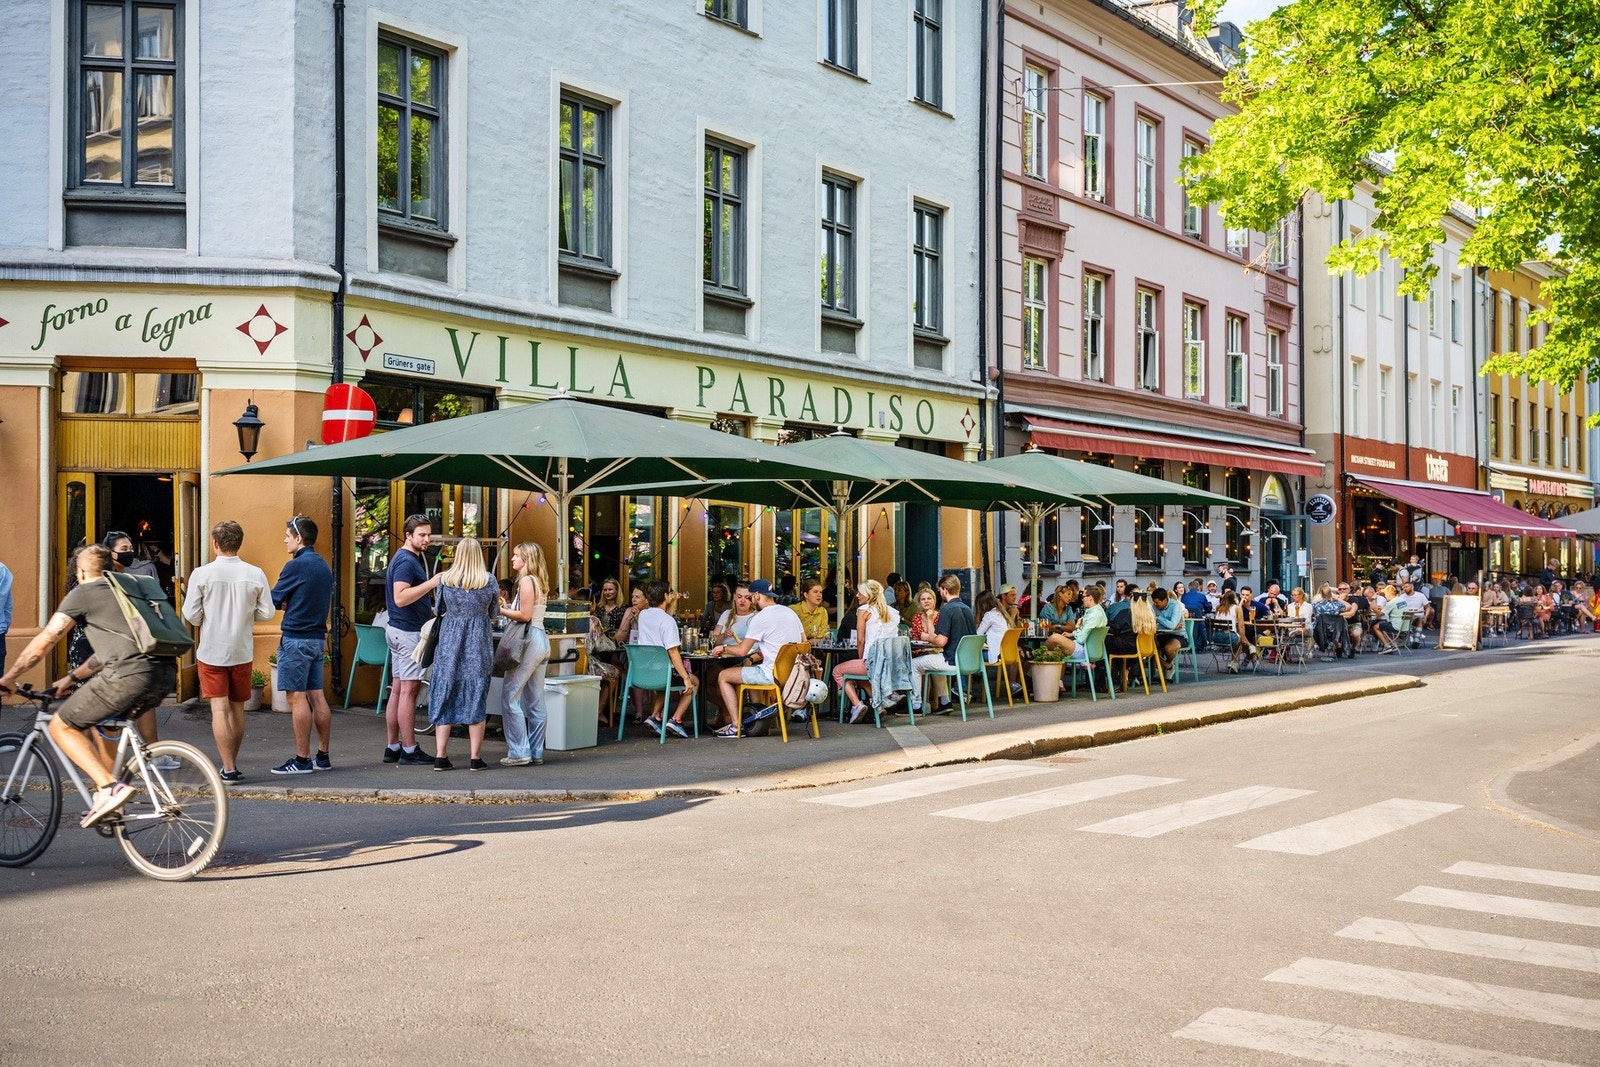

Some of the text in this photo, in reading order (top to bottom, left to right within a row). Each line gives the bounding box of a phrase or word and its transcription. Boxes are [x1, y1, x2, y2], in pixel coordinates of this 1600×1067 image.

[31, 298, 213, 352] forno a legna
[387, 356, 431, 372] Grüners gate
[445, 327, 935, 435] VILLA PARADISO
[1363, 456, 1377, 467] STREET
